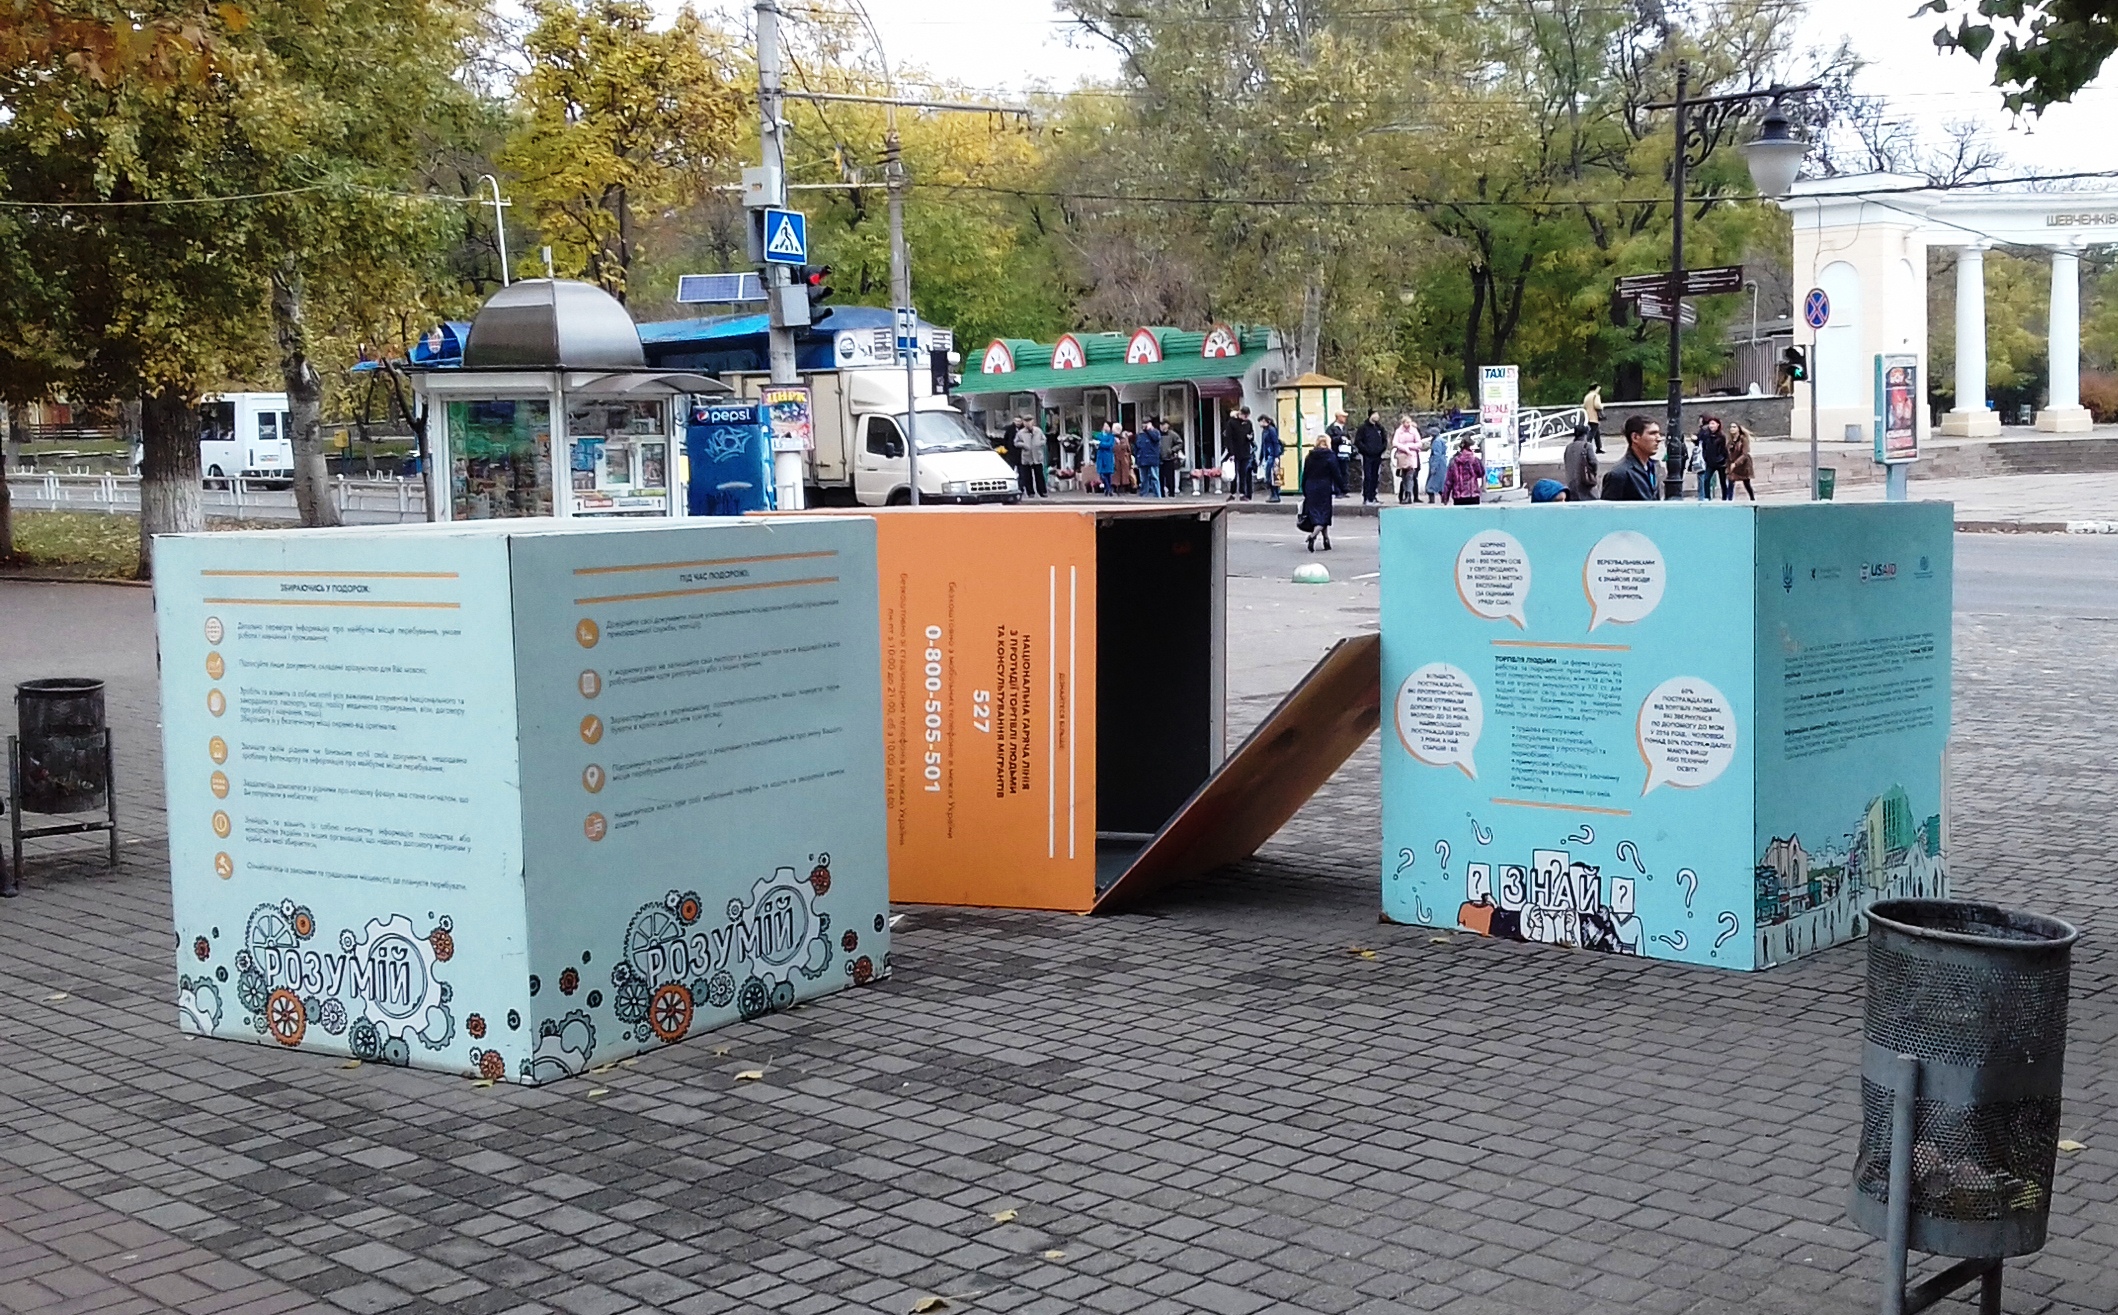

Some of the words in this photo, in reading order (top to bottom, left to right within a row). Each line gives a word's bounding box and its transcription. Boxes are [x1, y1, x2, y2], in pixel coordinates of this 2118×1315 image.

[2046, 213, 2118, 227] ШЕВЧЕНКІВ
[1484, 368, 1506, 379] TAXI
[711, 408, 751, 424] pepsi
[767, 391, 808, 403] ЦИРК
[280, 584, 324, 593] ЗБИРАЮЧИСЬ
[325, 585, 331, 593] У
[1871, 563, 1897, 577] USAID
[996, 624, 1005, 639] ТА
[1009, 638, 1019, 691] ПРОТИДІЇ
[1021, 634, 1031, 716] НАЦІОНАЛЬНА
[924, 624, 943, 792] 0-800-505-501
[973, 689, 991, 733] 527
[996, 640, 1005, 741] КОНСУЛЬТУВАННЯ
[1009, 692, 1019, 740] ТОРГІВЛІ
[1021, 717, 1031, 759] ГАРЯЧА
[1680, 740, 1732, 750] ПОСТРАДАЛИХ
[996, 742, 1005, 799] МІГРАНТІВ
[1008, 741, 1018, 795] ЛЮДЬМИ
[1021, 760, 1031, 791] ЛІНІЯ
[1503, 866, 1601, 914] ЗНАЙ
[645, 895, 795, 989] РОЗУМІЙ
[264, 946, 410, 1006] РОЗУМІЙ
